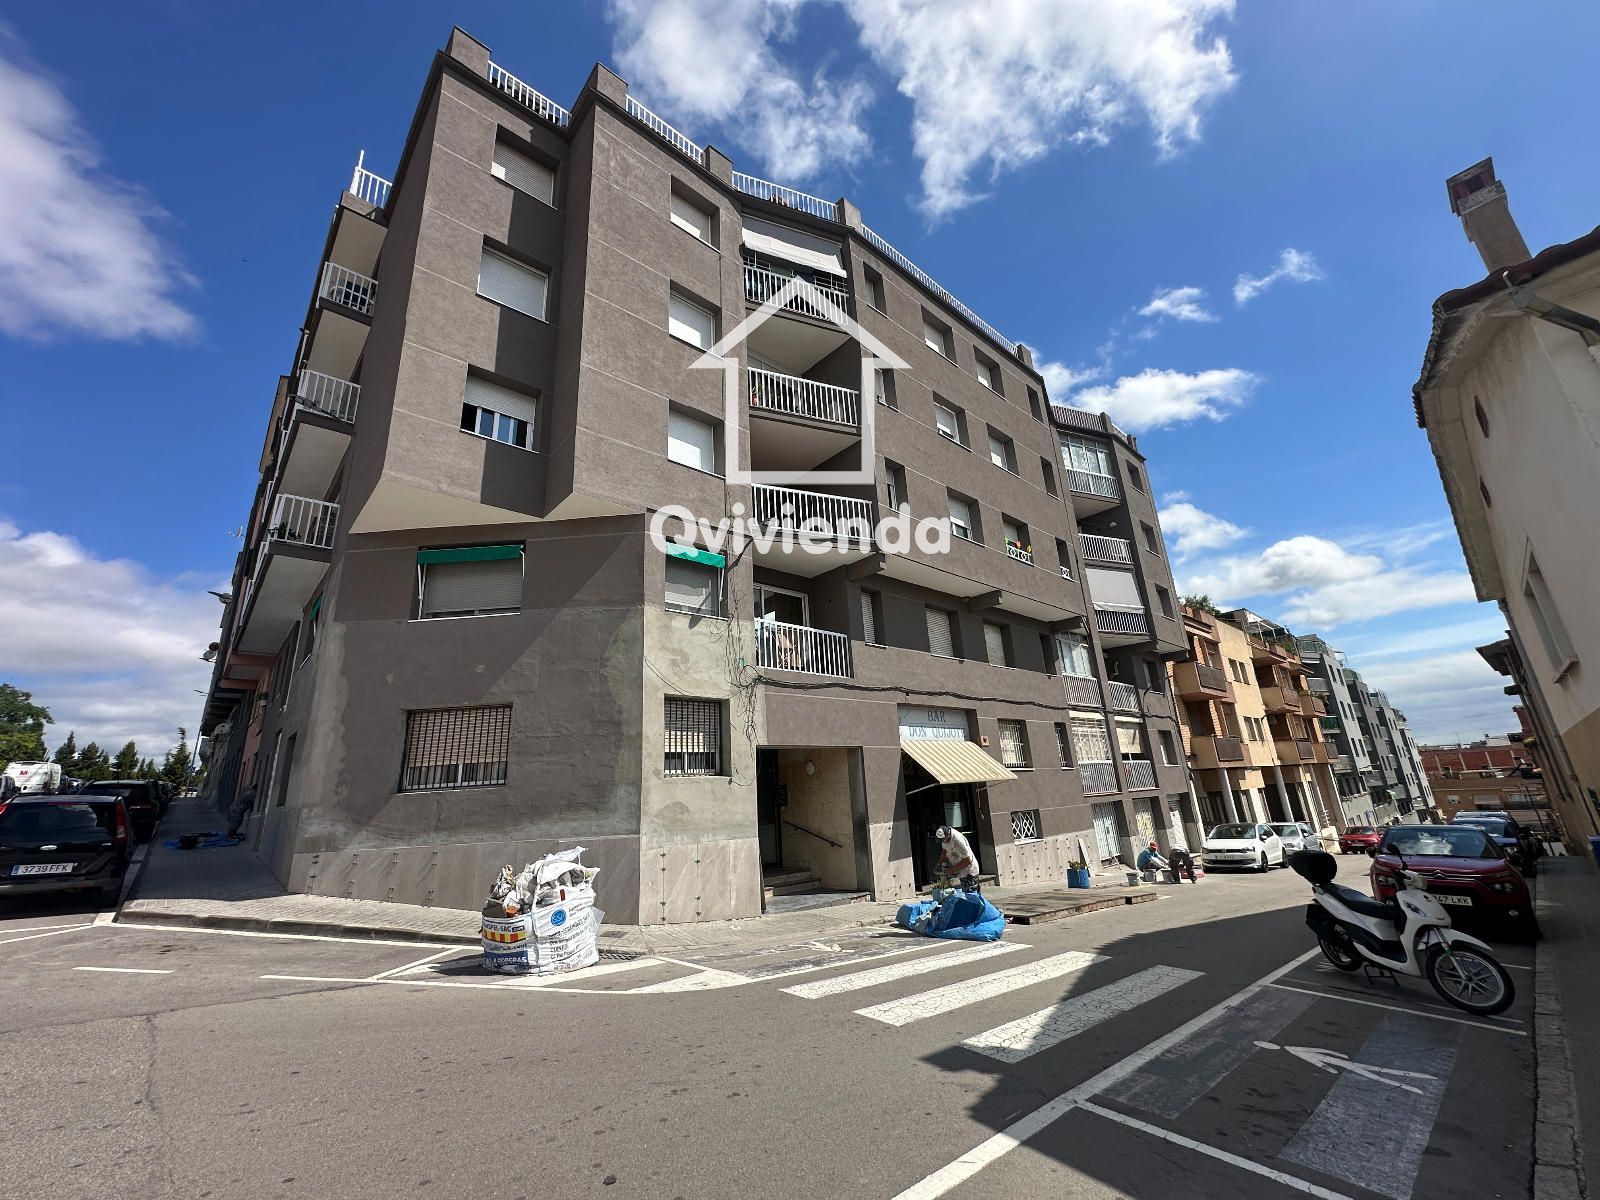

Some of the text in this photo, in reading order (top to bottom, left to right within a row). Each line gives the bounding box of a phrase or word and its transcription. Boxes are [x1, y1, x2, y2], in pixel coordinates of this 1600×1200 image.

[927, 710, 946, 722] BAR
[909, 725, 927, 738] DON
[22, 864, 69, 873] 3739 FFK
